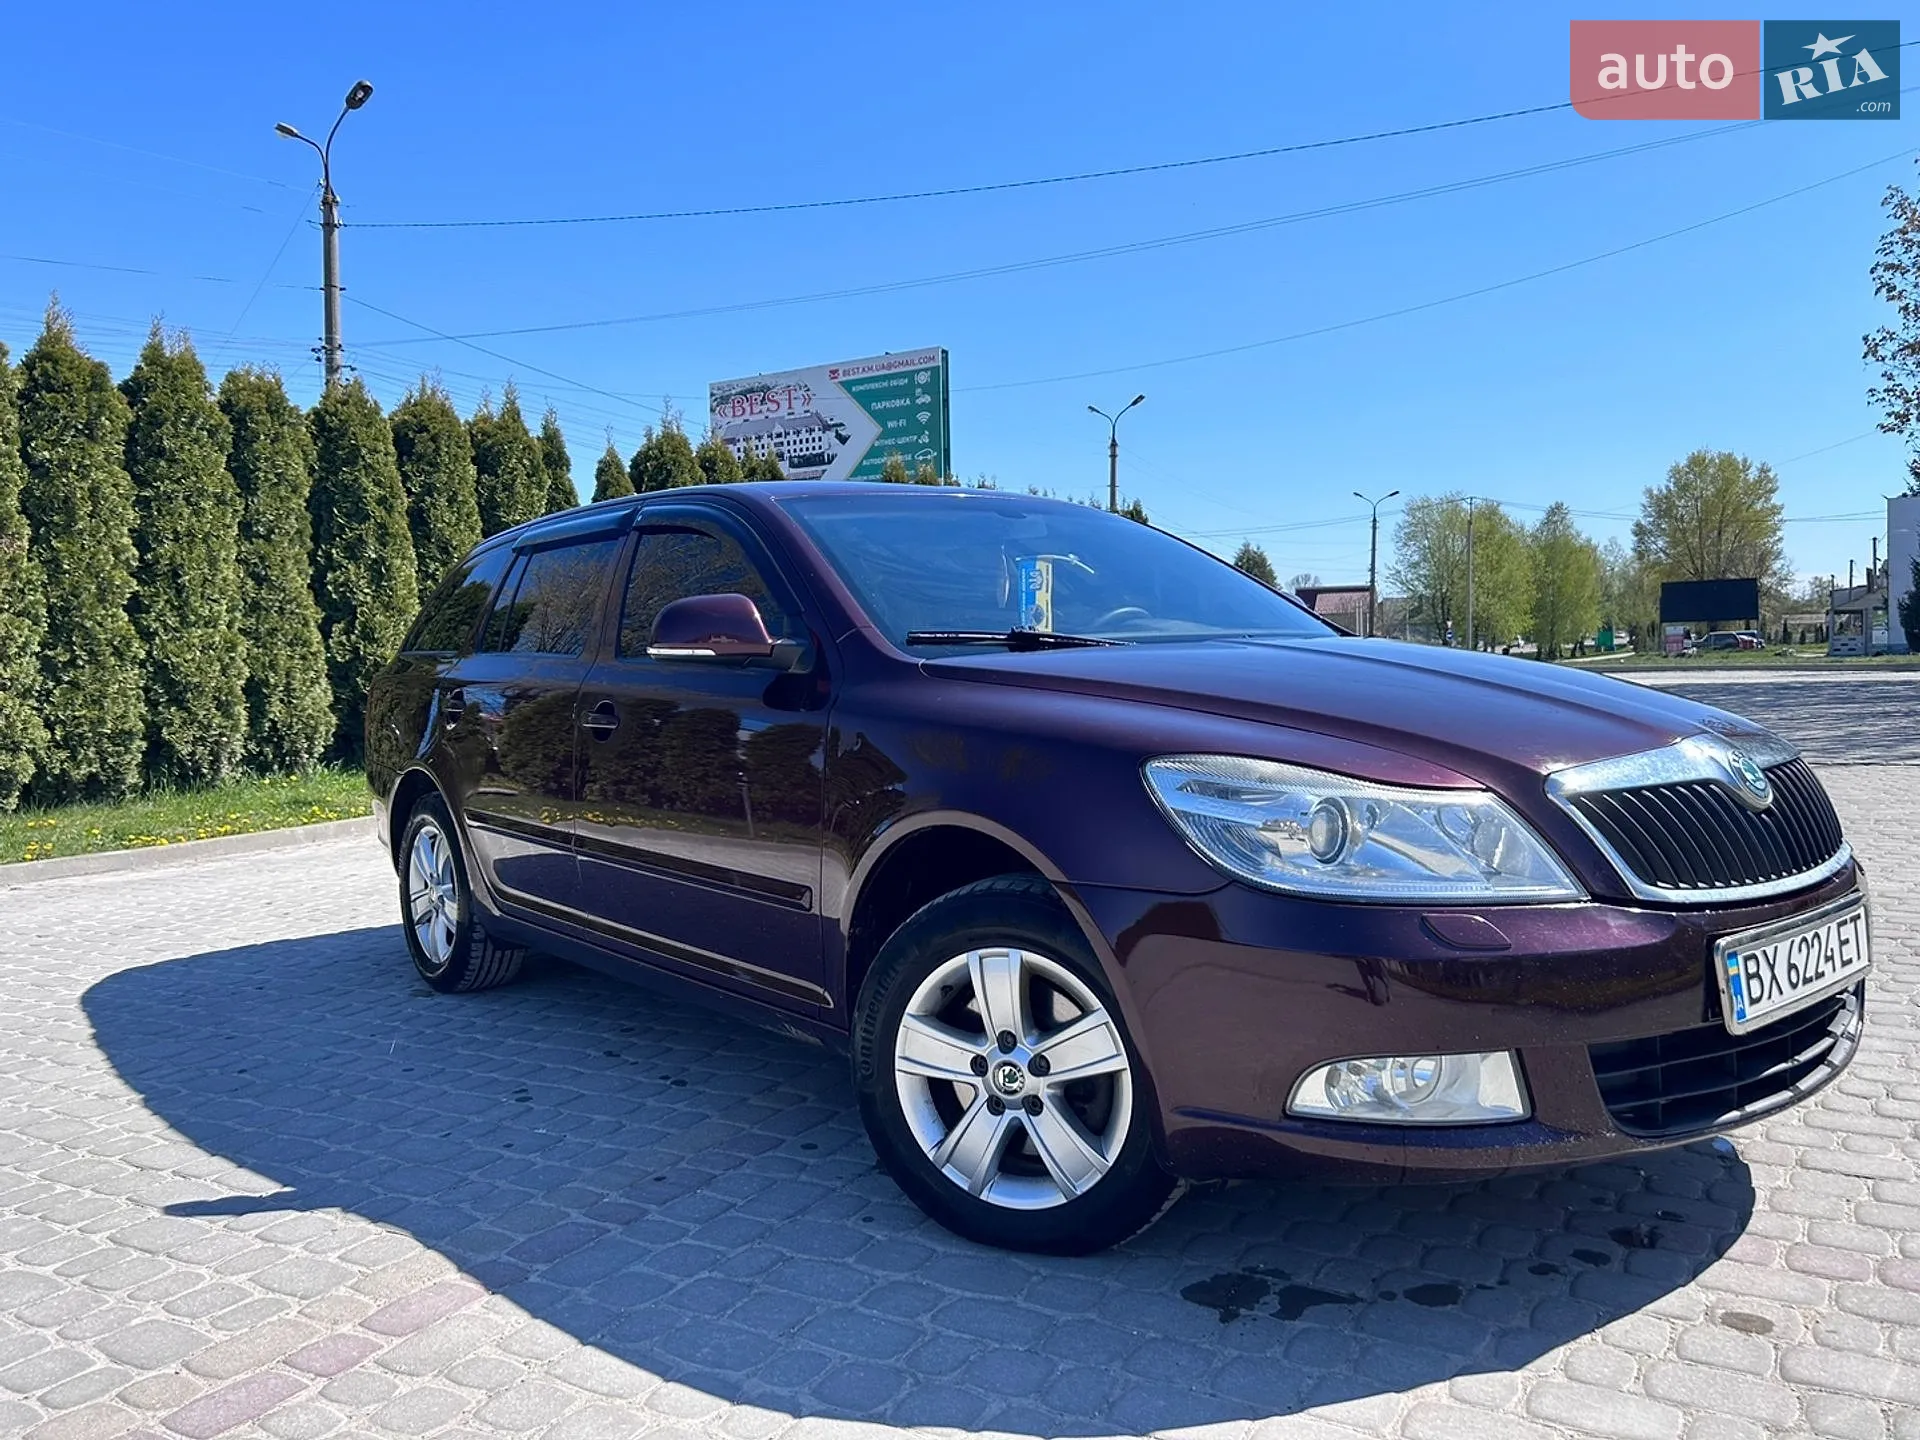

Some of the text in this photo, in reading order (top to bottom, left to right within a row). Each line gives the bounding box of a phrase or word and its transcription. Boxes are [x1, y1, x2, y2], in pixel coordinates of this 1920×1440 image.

[870, 398, 911, 412] ПАРКОВКА
[1743, 946, 1783, 1005] BX
[1787, 925, 1836, 989] 6224
